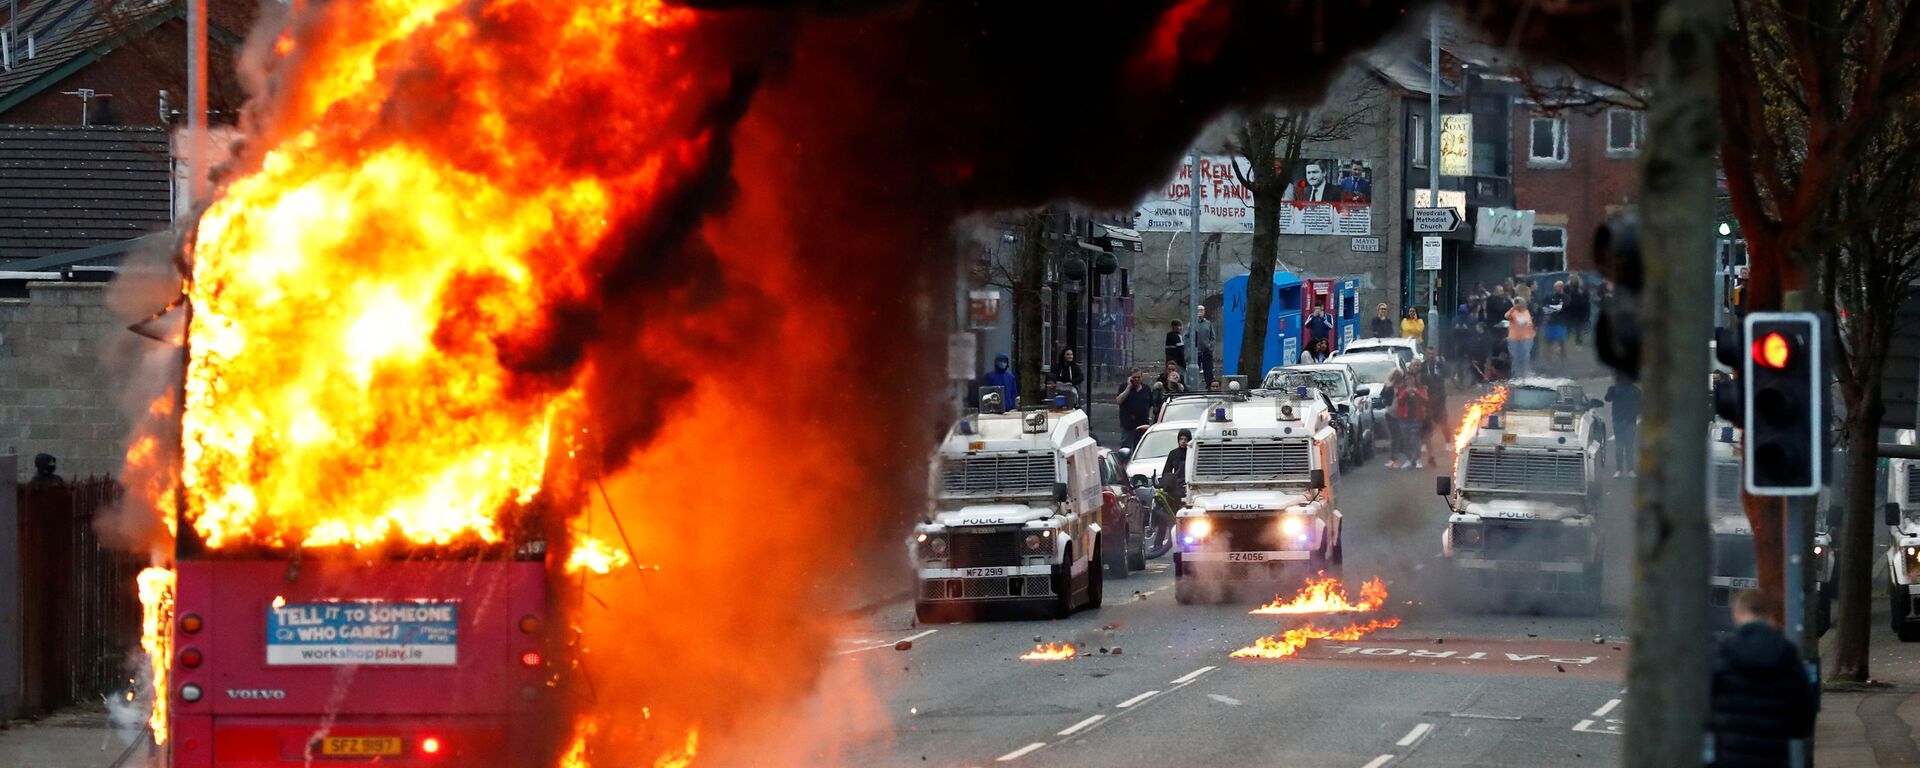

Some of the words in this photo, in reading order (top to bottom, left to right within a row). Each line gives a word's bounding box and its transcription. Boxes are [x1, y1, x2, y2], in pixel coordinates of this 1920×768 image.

[1200, 158, 1234, 180] REAL
[1242, 552, 1264, 560] 4056
[984, 568, 1003, 576] 2919
[274, 607, 323, 625] TELL
[325, 607, 340, 619] IT
[344, 608, 366, 622] TO
[369, 606, 452, 623] SOMEONE
[297, 626, 336, 642] WHO
[339, 624, 400, 640] CARES!
[301, 646, 423, 661] workshopplay.ie
[226, 688, 286, 699] VOLVO
[330, 738, 359, 752] SFZ
[362, 738, 393, 752] 9197
